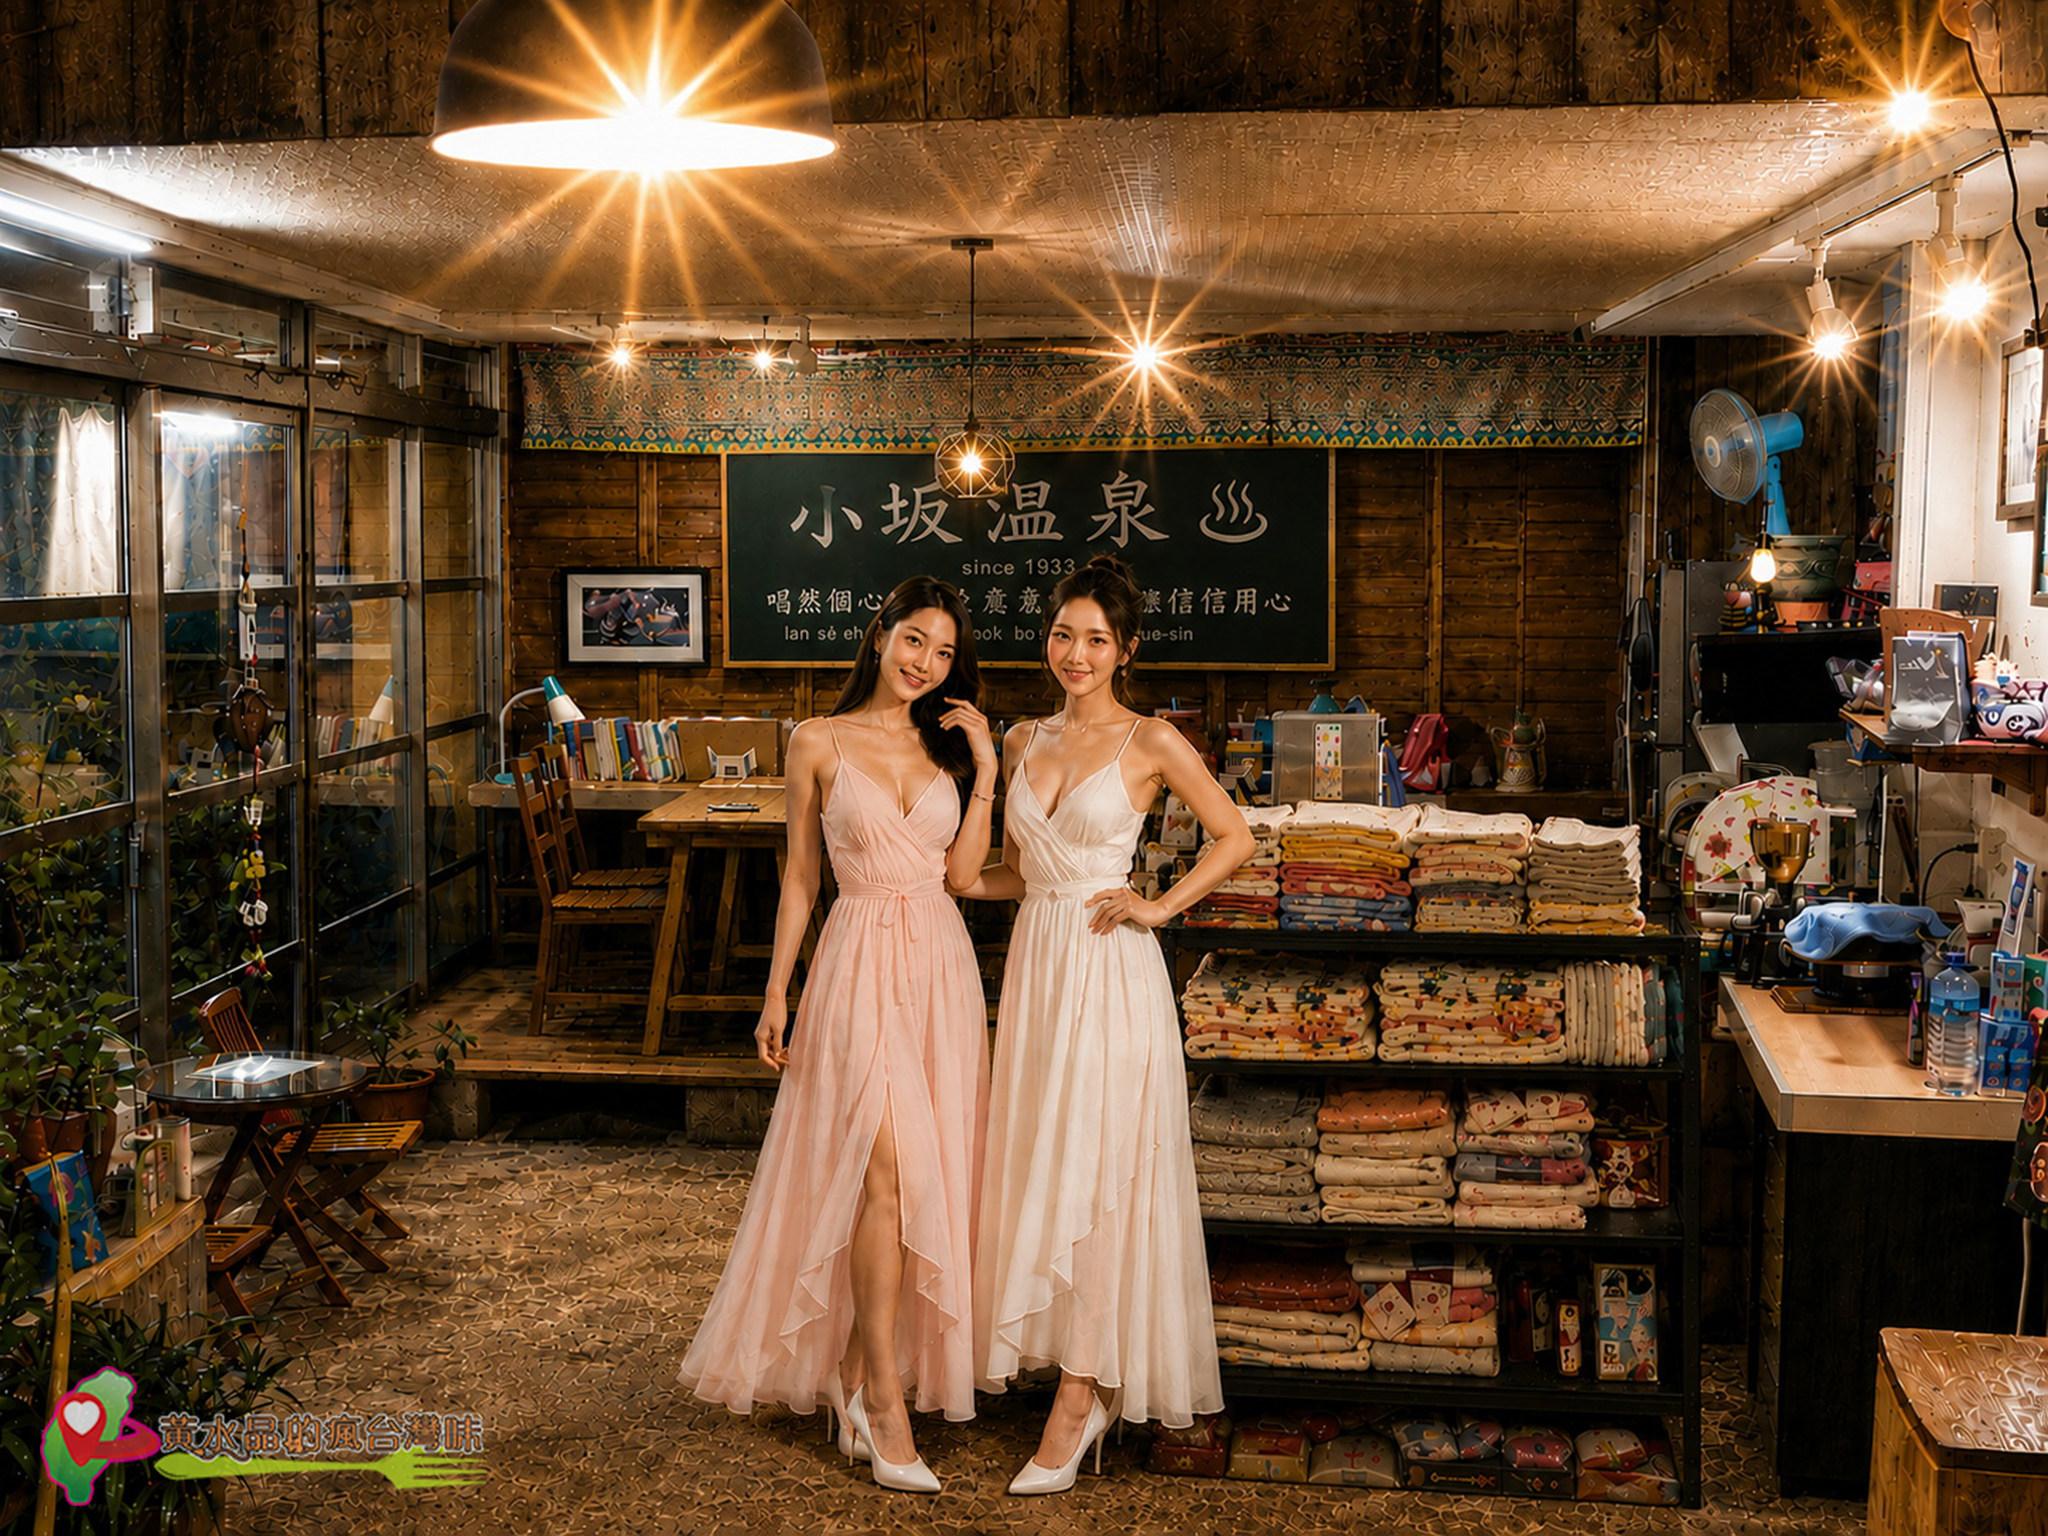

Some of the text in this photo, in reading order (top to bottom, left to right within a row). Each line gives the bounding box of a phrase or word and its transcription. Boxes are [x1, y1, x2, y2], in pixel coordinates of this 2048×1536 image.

[790, 470, 1170, 548] 小坂温泉
[962, 558, 1076, 575] since 1933
[784, 625, 809, 640] lan
